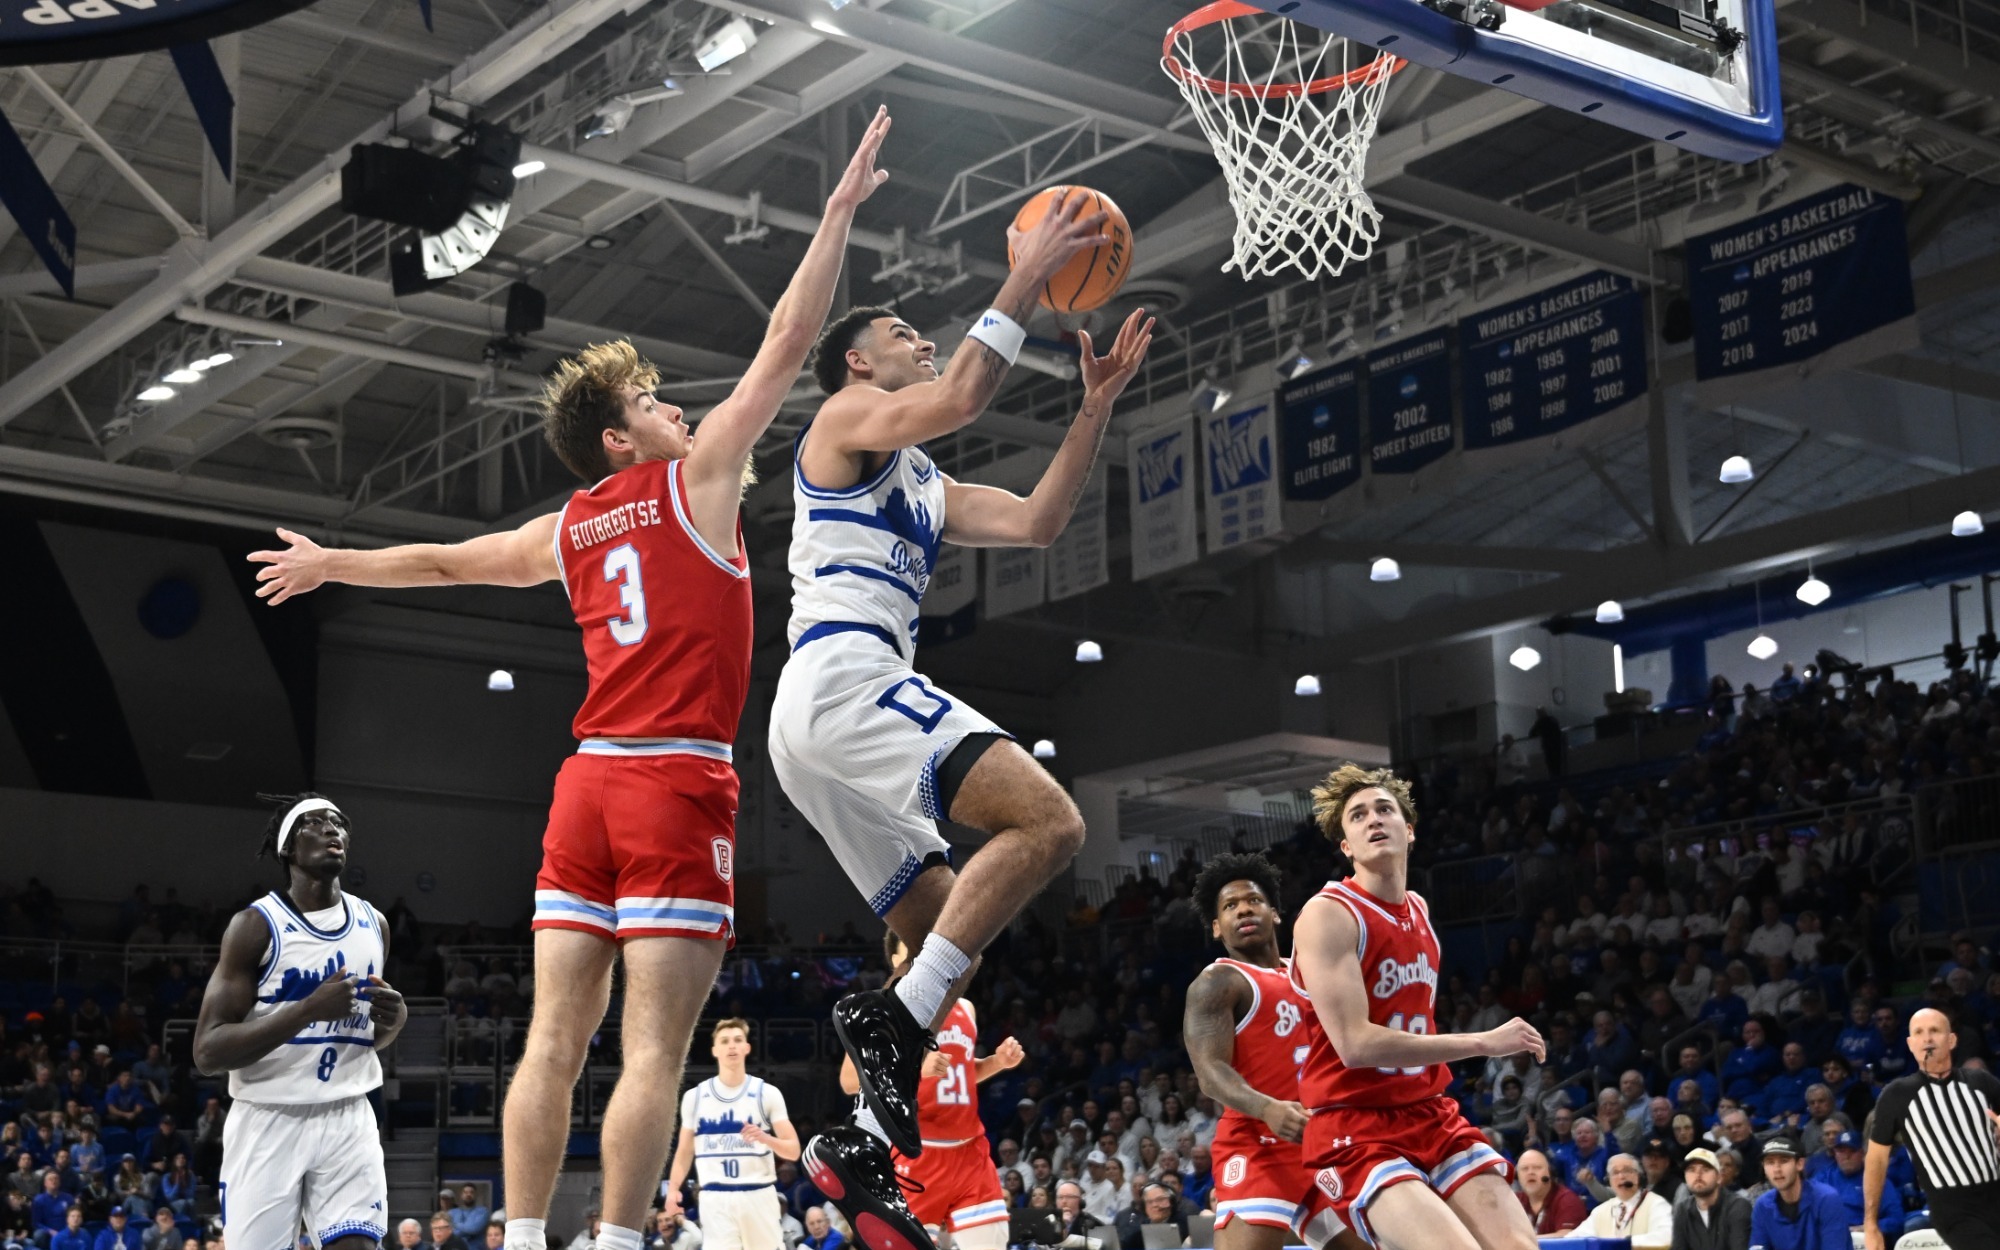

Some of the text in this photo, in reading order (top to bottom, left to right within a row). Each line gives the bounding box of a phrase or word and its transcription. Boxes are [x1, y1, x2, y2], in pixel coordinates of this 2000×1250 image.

[1710, 223, 1778, 261] WOMEN'S
[1752, 226, 1857, 279] APPEARANCES
[1780, 269, 1814, 295] 2019
[1477, 275, 1619, 339] WOMEN'S BASKETBALL
[1718, 290, 1749, 315] 2007
[1780, 295, 1814, 321] 2023
[1513, 309, 1604, 356] APPEARANCES
[1720, 315, 1750, 341] 2017
[1782, 321, 1818, 347] 2024
[1536, 349, 1565, 371] 1995
[1590, 354, 1622, 378] 2001
[1721, 343, 1755, 367] 2018
[1539, 374, 1568, 396] 1997
[1593, 380, 1625, 404] 2002
[1393, 403, 1427, 431] 2002
[1307, 434, 1337, 459] 1982
[1372, 424, 1451, 461] SWEET SIXTEEN
[1294, 455, 1352, 487] ELITE EIGHT
[569, 499, 661, 551] HUIBREGTSE
[603, 542, 649, 647] 3
[875, 676, 952, 735] D
[1373, 952, 1438, 1009] Bradley
[317, 1047, 337, 1082] 8
[936, 1063, 971, 1105] 21
[720, 1159, 740, 1178] 10
[1228, 1162, 1241, 1181] B
[1319, 1170, 1339, 1196] B
